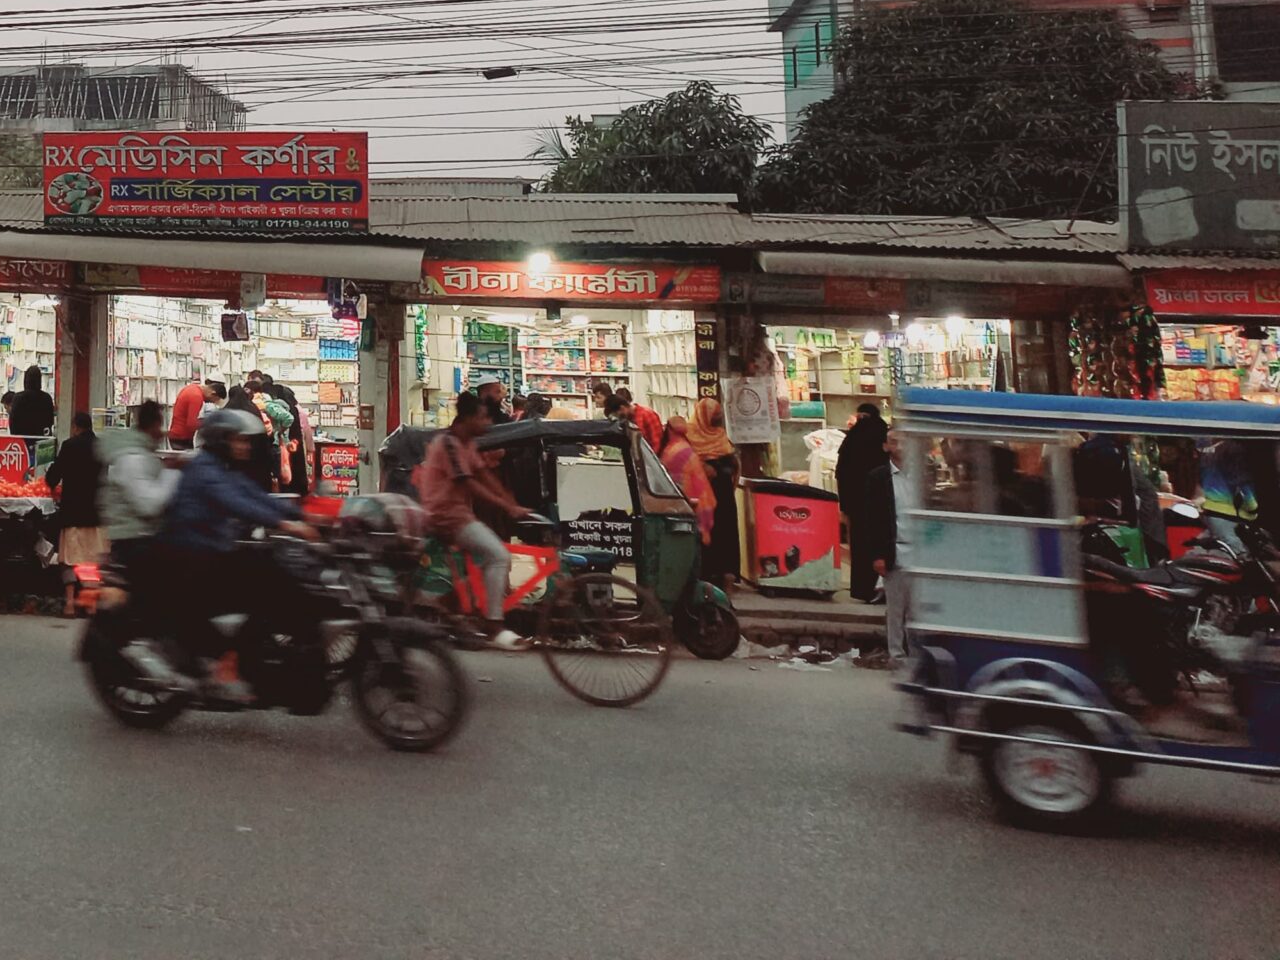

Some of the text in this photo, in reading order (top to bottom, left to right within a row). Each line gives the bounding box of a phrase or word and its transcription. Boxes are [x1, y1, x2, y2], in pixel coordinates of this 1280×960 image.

[45, 146, 75, 167] RX
[78, 135, 228, 175] মেডিসিন
[236, 135, 340, 175] কর্ণার
[1139, 125, 1199, 175] নিউ
[110, 184, 130, 197] RX
[131, 180, 358, 202] সার্জিক্যাল সেন্টার
[442, 267, 522, 294] বীনা
[527, 268, 658, 296] ফার্মেসী
[568, 520, 602, 531] এখানে
